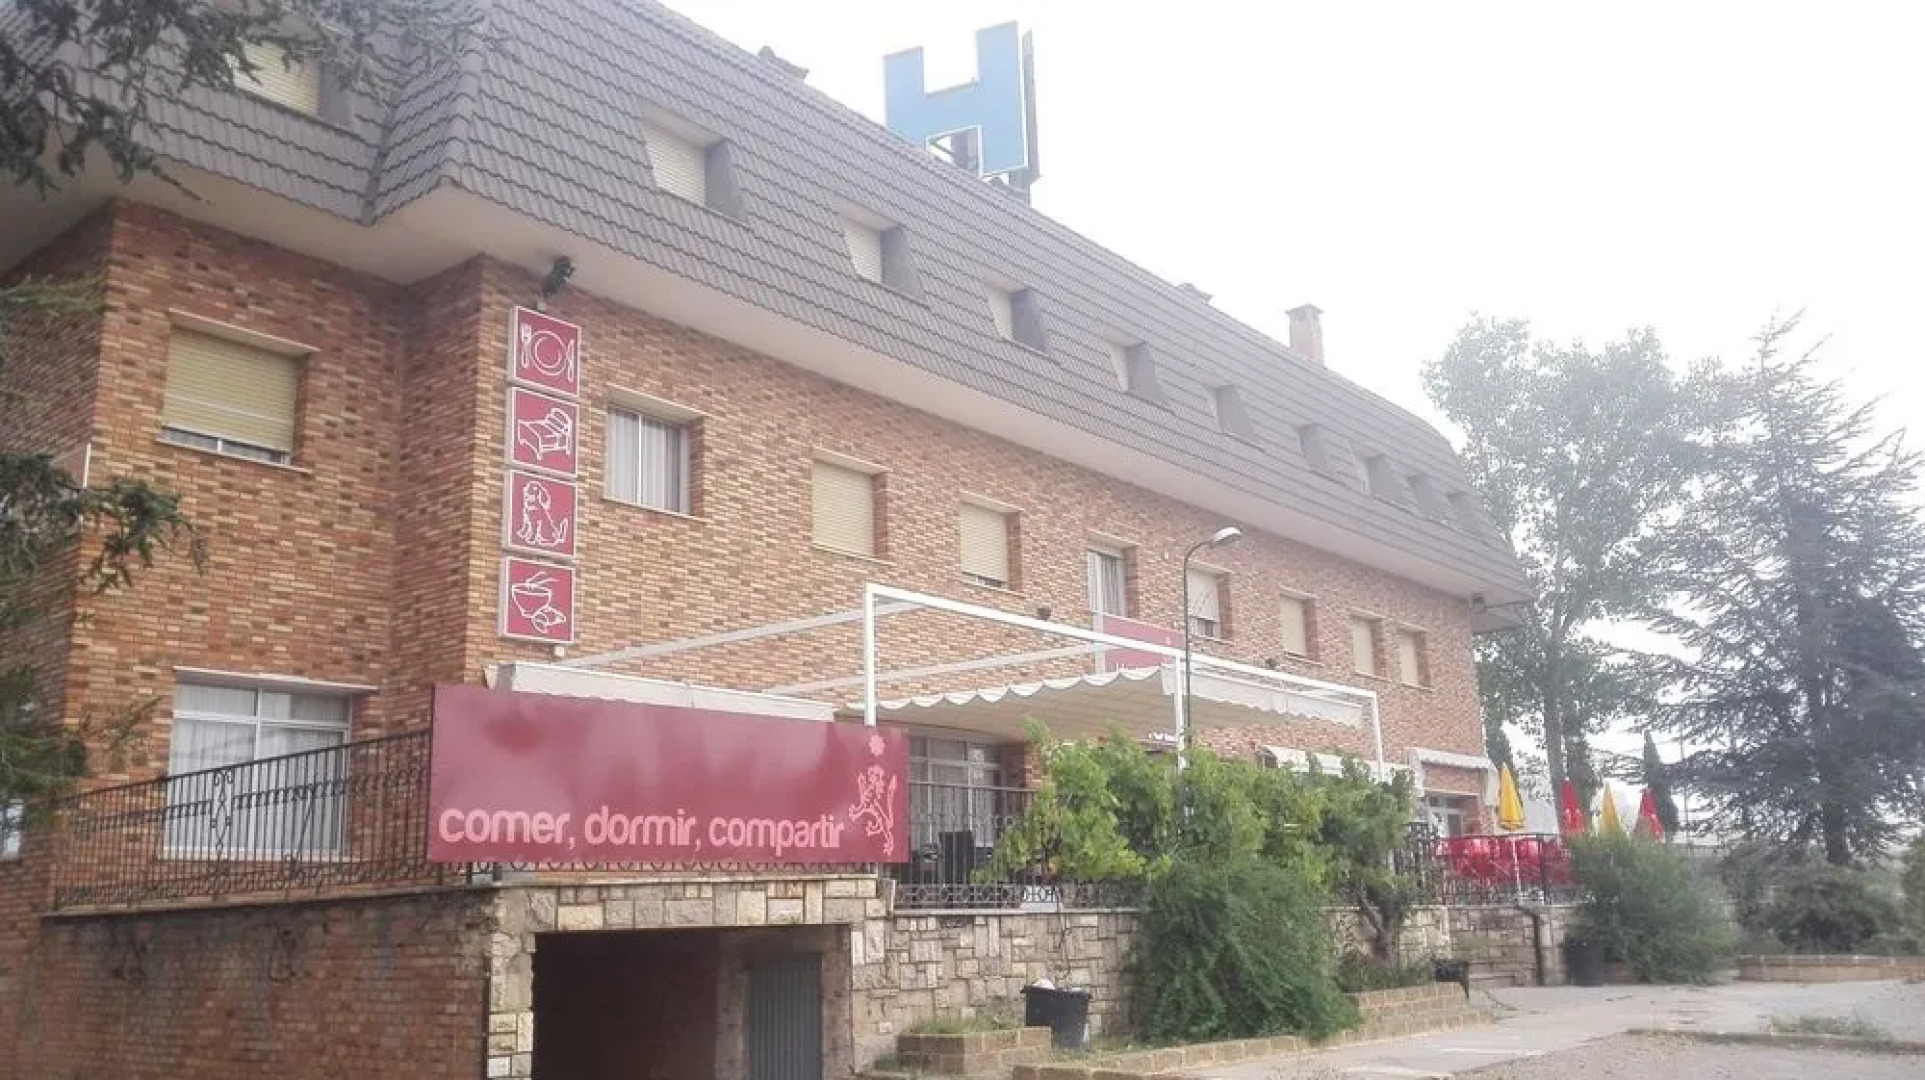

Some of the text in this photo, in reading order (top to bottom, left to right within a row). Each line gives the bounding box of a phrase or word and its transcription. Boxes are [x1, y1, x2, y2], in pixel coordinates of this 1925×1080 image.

[882, 20, 1028, 179] H
[438, 805, 845, 857] comer, dormir, compartir
